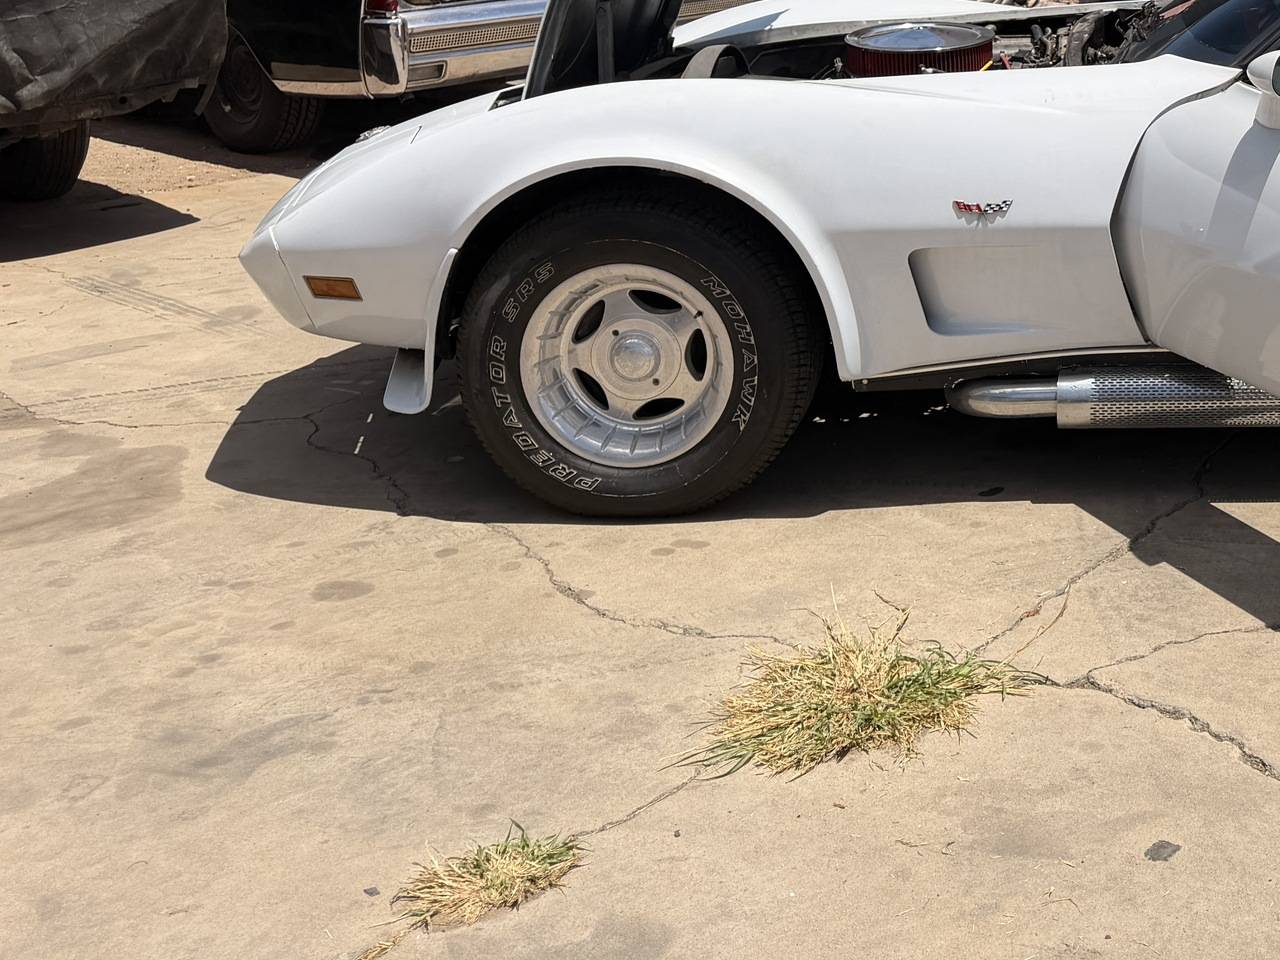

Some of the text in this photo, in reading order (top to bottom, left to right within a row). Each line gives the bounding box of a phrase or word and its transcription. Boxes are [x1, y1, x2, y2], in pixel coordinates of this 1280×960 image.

[489, 262, 602, 491] PREDATOR SRS
[700, 277, 758, 431] MOHAWK
